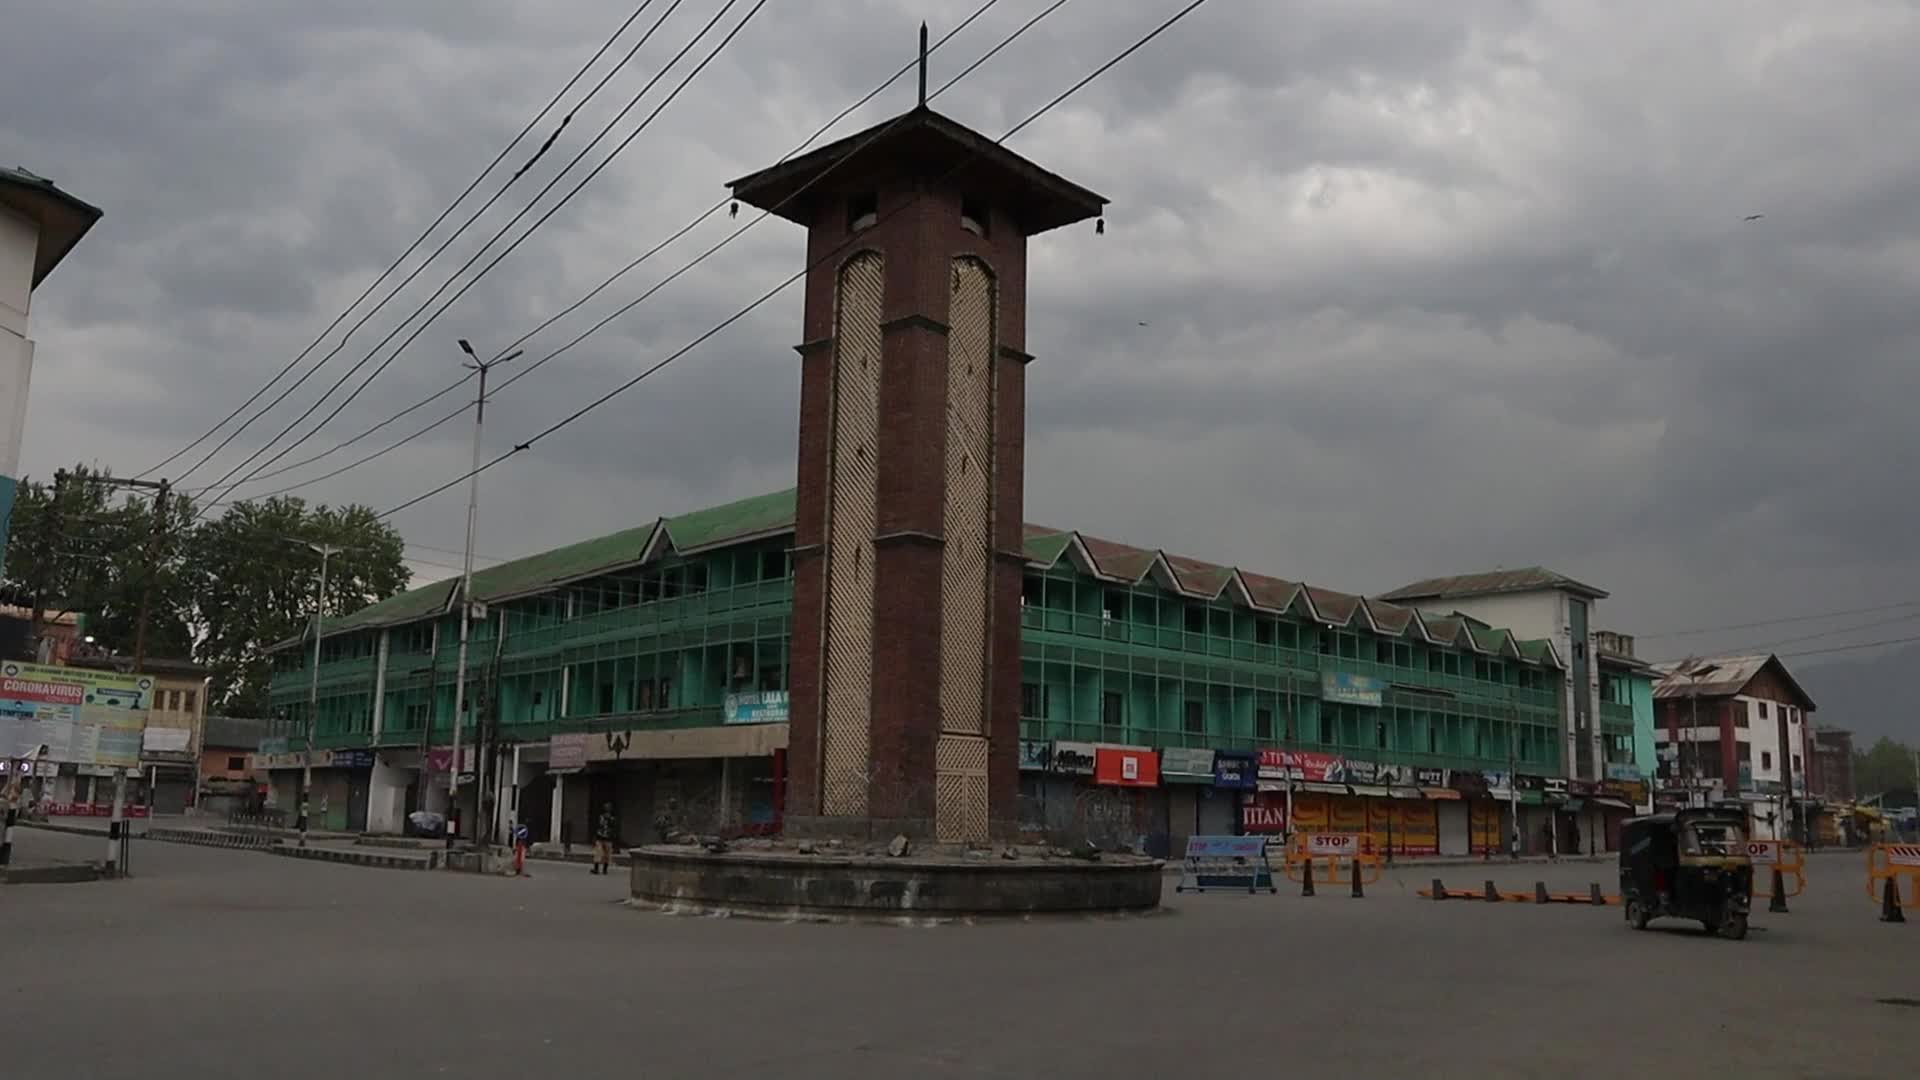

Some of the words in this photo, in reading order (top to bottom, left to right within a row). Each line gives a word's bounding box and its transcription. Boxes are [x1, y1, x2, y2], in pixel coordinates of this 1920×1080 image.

[3, 679, 82, 698] CORONAVIRUS
[1243, 807, 1284, 825] TITAN
[1316, 836, 1349, 847] STOP
[1748, 844, 1768, 855] OP
